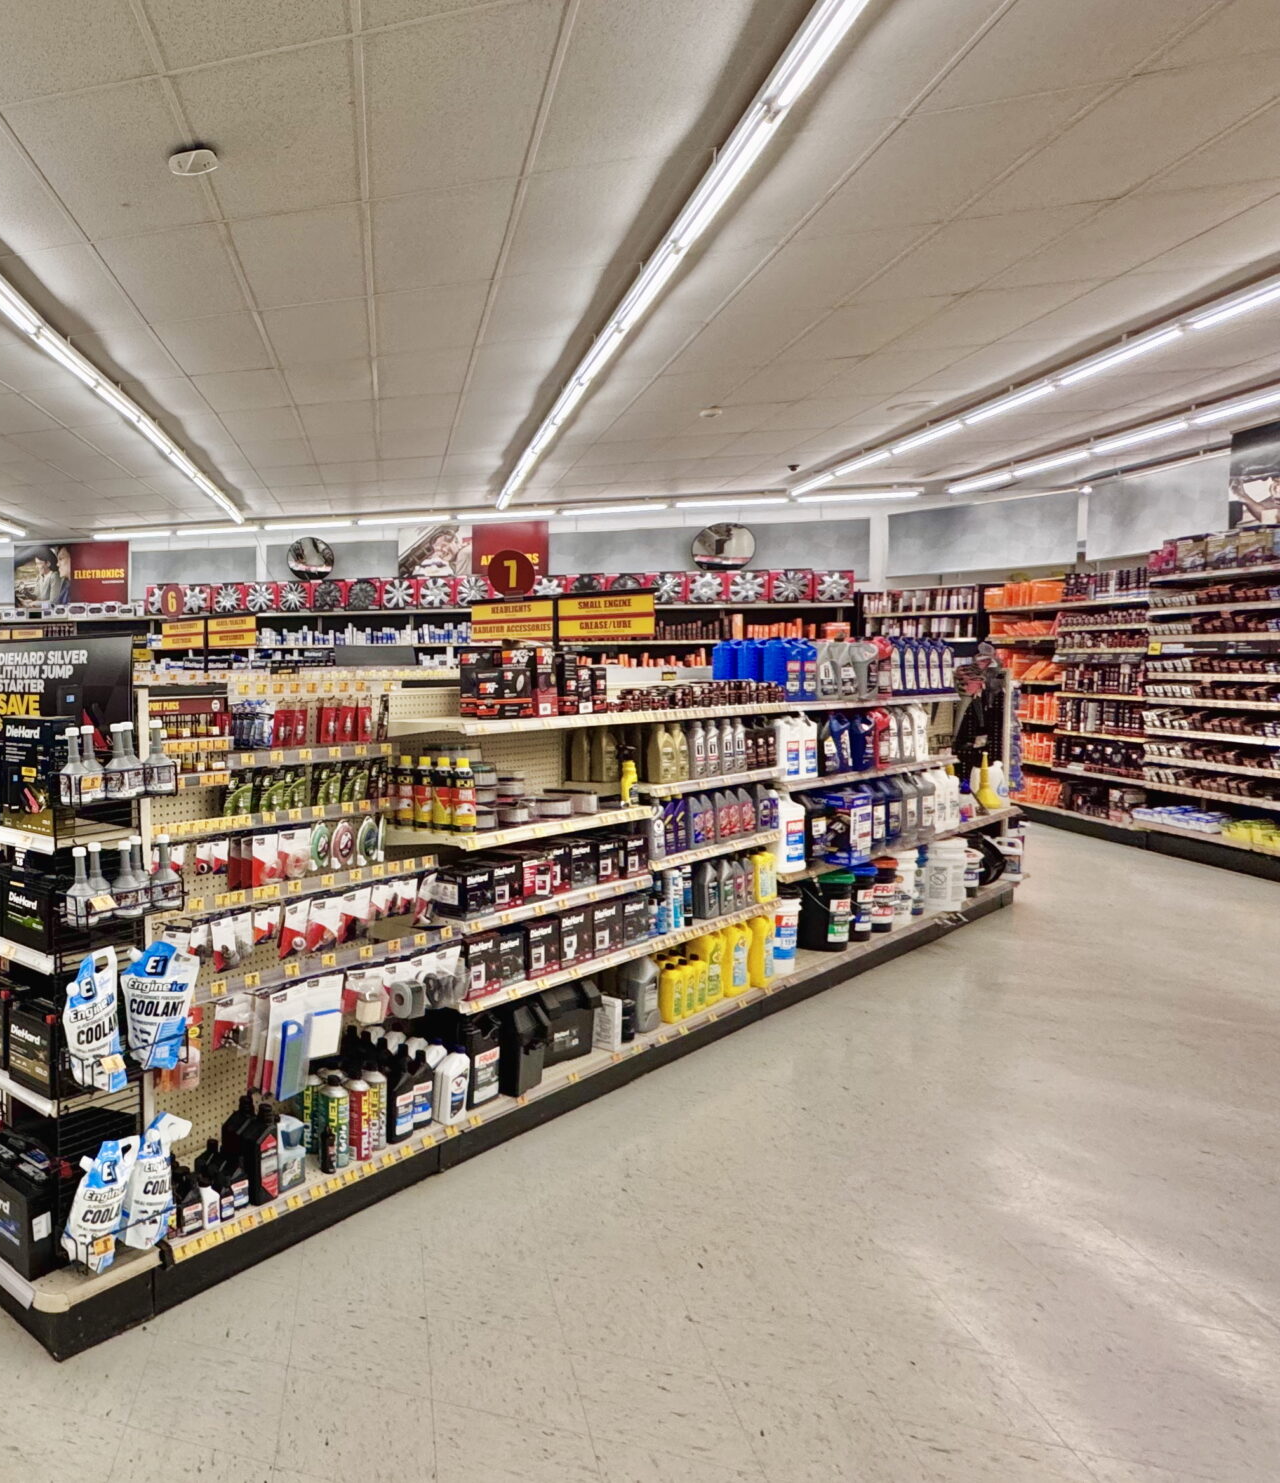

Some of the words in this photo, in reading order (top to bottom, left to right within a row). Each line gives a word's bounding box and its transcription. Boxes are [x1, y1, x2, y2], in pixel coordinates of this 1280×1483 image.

[74, 568, 125, 580] ELECTRONICS
[504, 559, 517, 588] 1
[167, 590, 176, 612] 6
[490, 604, 532, 614] HEADLIGHTS
[578, 600, 602, 610] SMALL
[604, 598, 632, 608] ENGINE
[506, 624, 552, 632] ACCESSORIES
[48, 650, 88, 664] SILVER
[42, 665, 74, 679] JUMP
[5, 725, 40, 739] DieHard
[8, 890, 38, 910] DieHard
[562, 912, 584, 928] DieHard
[594, 906, 616, 921] DieHard
[130, 998, 185, 1018] COOLANT
[10, 1024, 41, 1046] DieHard
[76, 1011, 118, 1046] COOLA
[328, 1099, 338, 1135] FUEL
[361, 1092, 369, 1158] TRUFUEL
